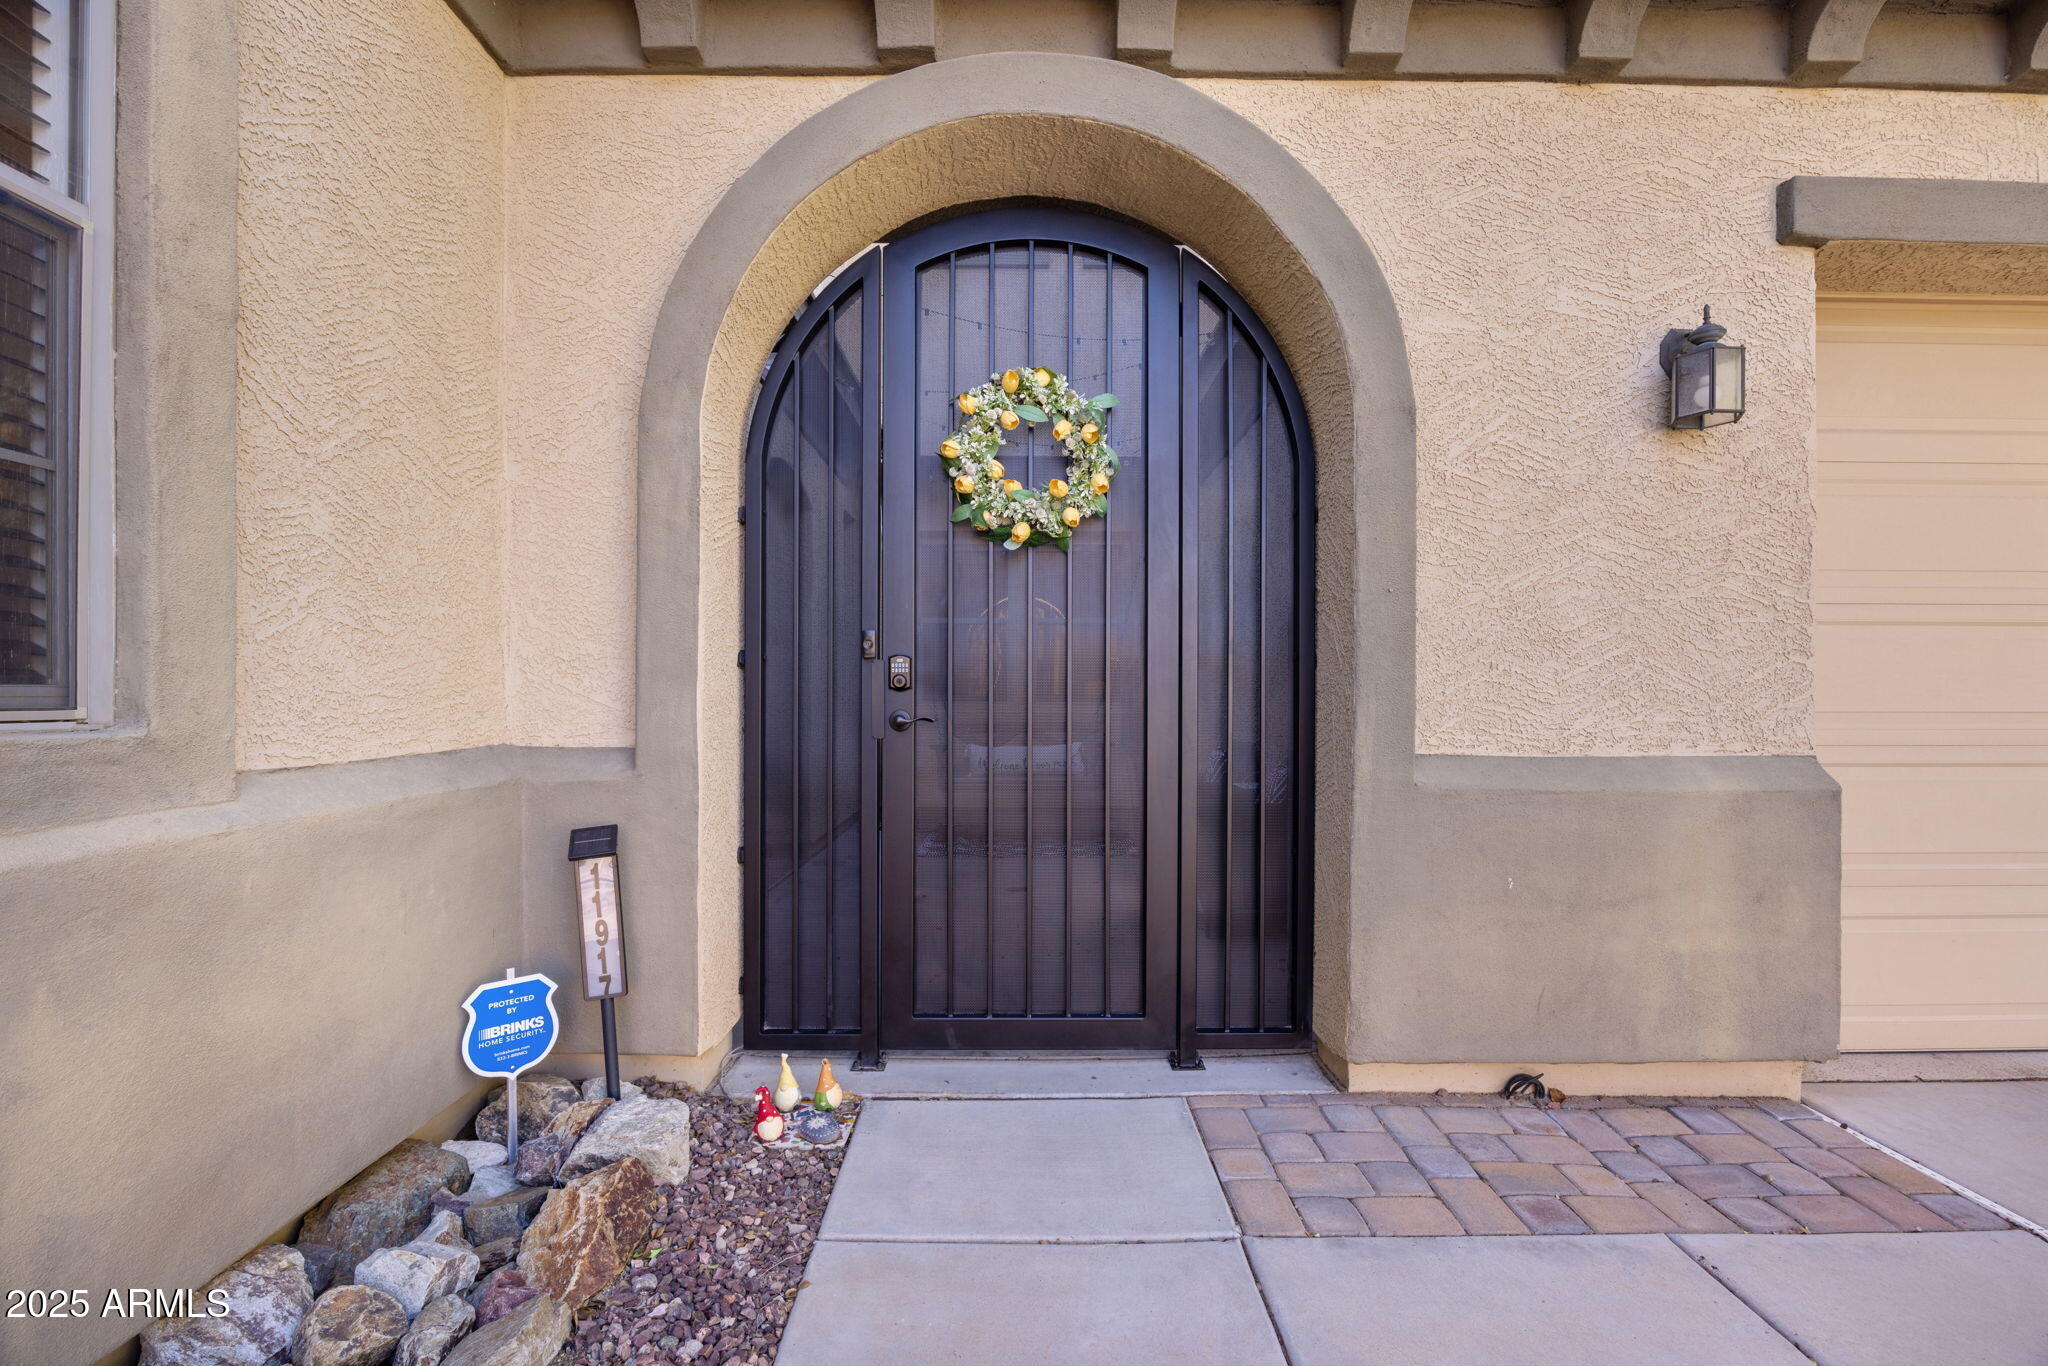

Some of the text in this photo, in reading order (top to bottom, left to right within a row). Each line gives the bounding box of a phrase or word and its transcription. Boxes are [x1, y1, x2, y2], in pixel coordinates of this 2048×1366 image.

[590, 863, 612, 996] 11917
[488, 994, 535, 1010] PROTECTED
[506, 1007, 518, 1015] BY
[478, 1027, 544, 1049] HOME SECURITY
[489, 1016, 545, 1038] BRINKS
